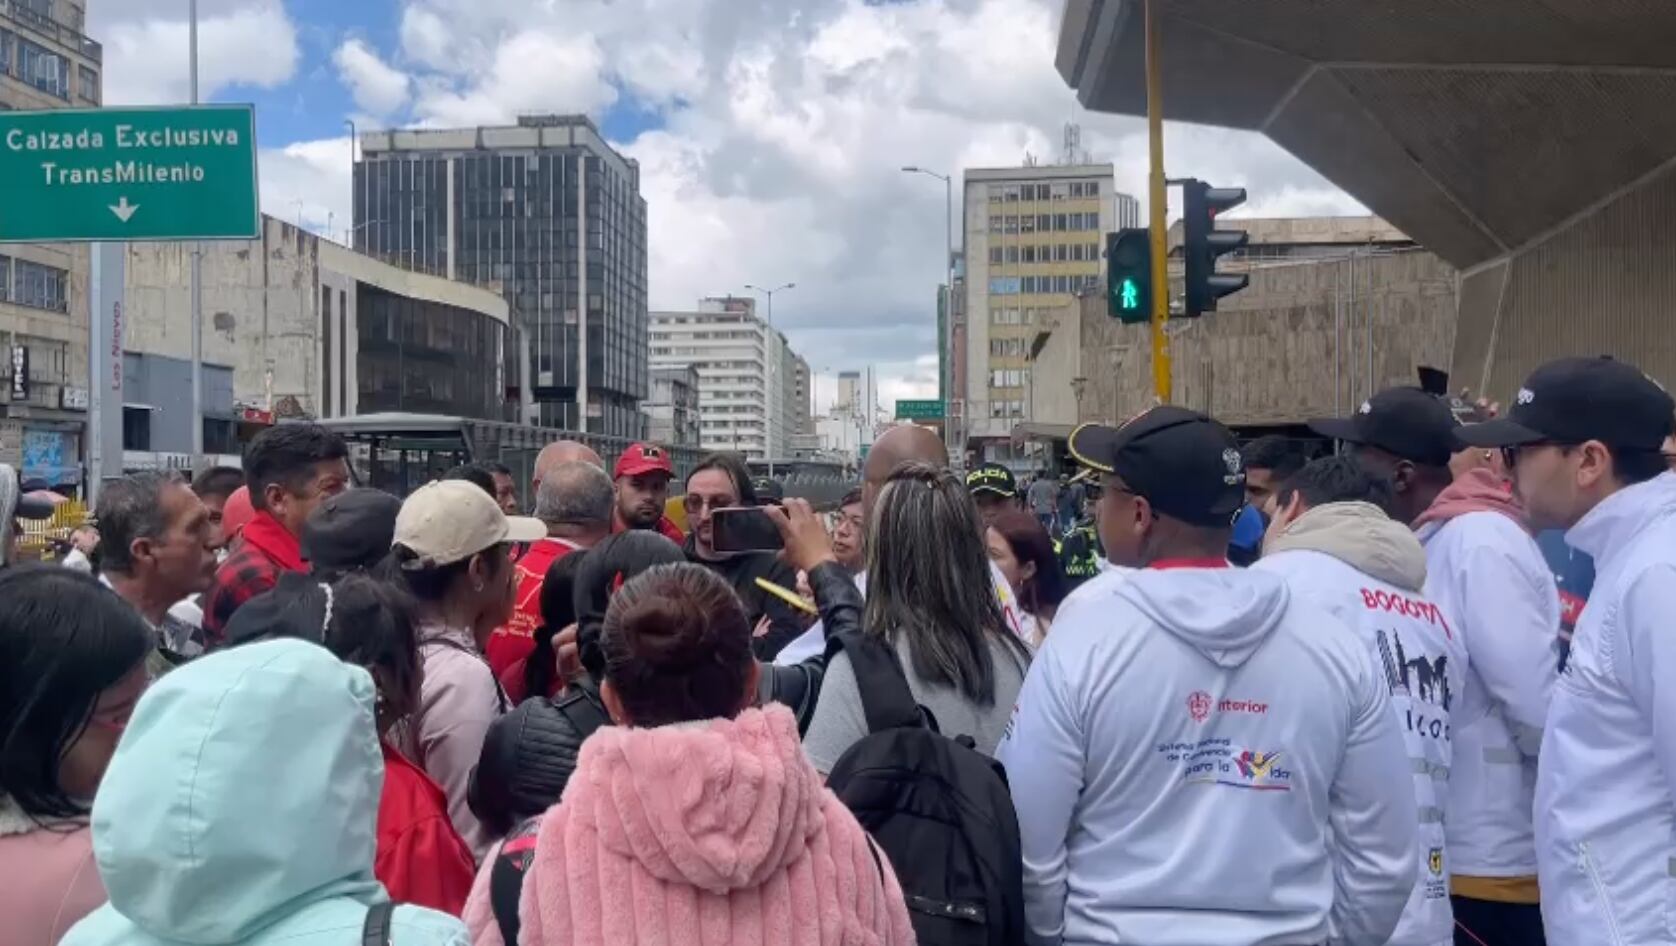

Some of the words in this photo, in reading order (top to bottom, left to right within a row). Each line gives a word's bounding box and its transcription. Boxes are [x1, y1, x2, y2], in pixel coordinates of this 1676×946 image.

[6, 127, 104, 151] Calzada
[115, 124, 239, 148] Exclusiva
[40, 160, 205, 185] TransMilenio
[1217, 699, 1268, 714] nterior
[1184, 762, 1213, 778] para
[1218, 759, 1230, 772] la
